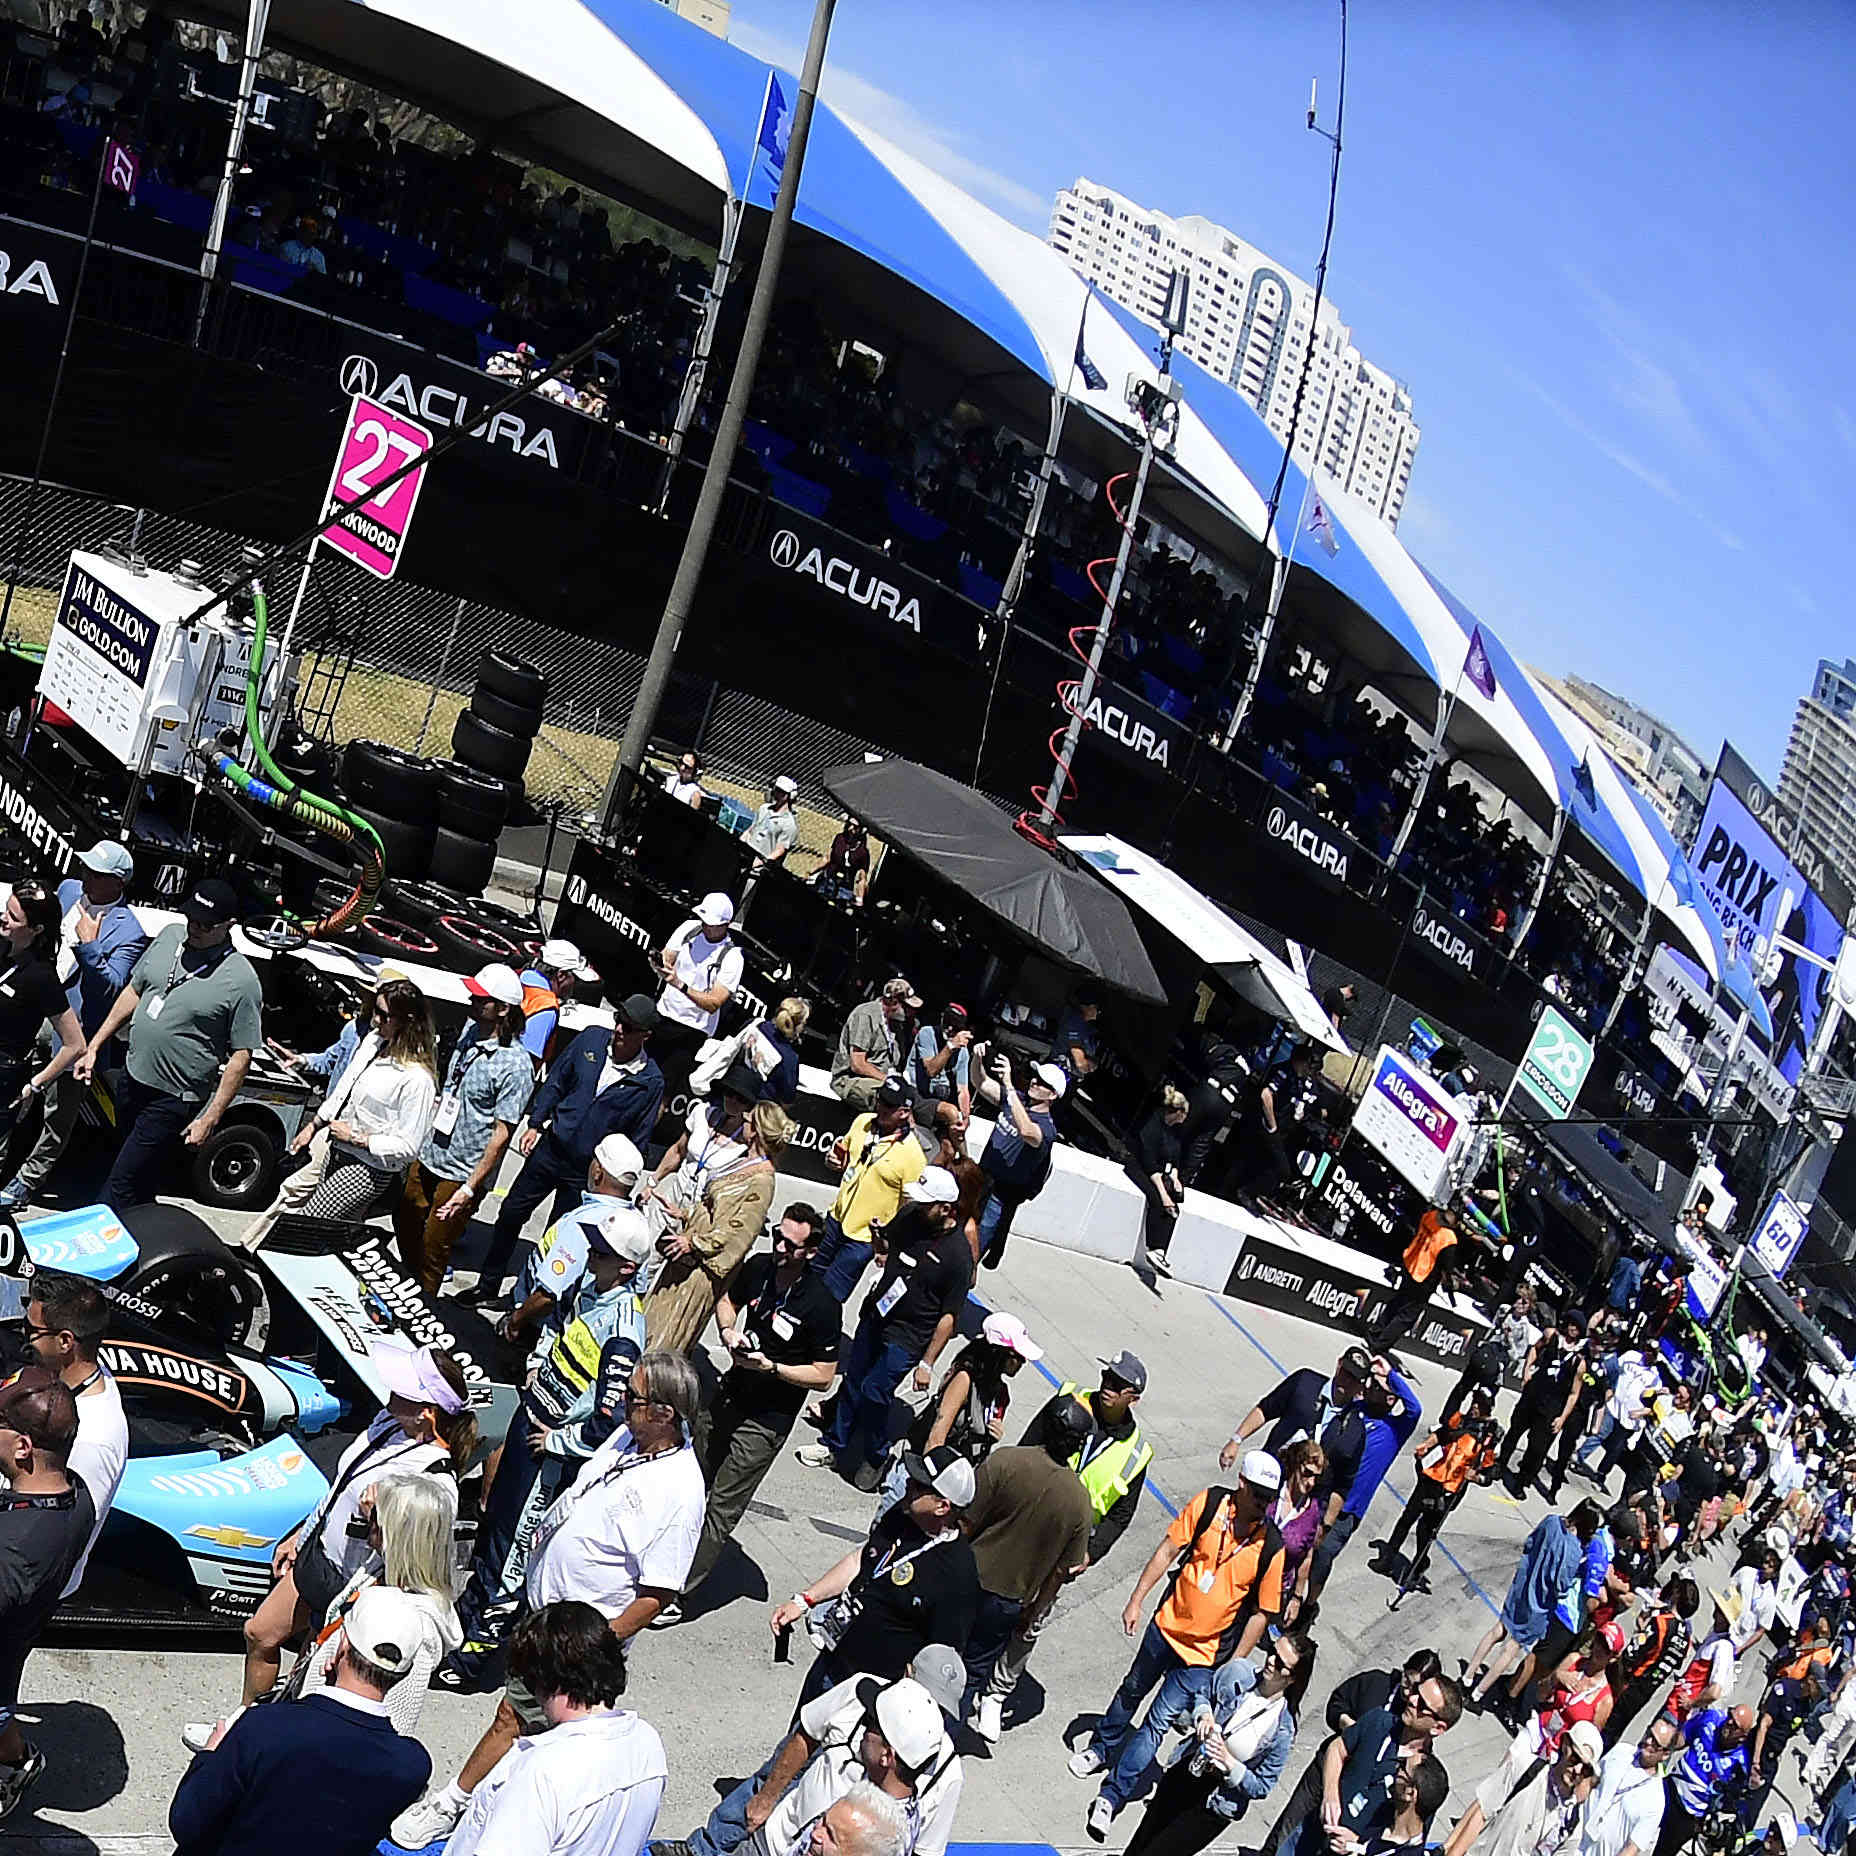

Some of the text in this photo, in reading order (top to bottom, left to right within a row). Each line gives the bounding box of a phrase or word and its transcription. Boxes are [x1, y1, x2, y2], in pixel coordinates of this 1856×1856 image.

[111, 147, 133, 191] 27
[379, 374, 559, 469] ACURA
[341, 421, 426, 508] 27
[329, 503, 397, 553] KKWOOD
[71, 570, 151, 647] JM BULLION
[795, 547, 921, 632] ACURA
[79, 617, 142, 677] GOLD.COM
[1084, 697, 1168, 769] ACURA
[1282, 820, 1348, 882] ACURA
[1699, 826, 1775, 923] PRIX
[1765, 816, 1824, 893] ACURA
[587, 893, 651, 950] ANDRETTI
[1421, 919, 1475, 972] ACURA
[1535, 1023, 1584, 1087] 28
[1382, 1071, 1439, 1133] Allegra
[1524, 1061, 1569, 1111] ERICSSON
[1766, 1219, 1792, 1252] 60
[117, 1293, 163, 1319] ROSSI
[314, 1285, 358, 1318] PEEL
[1254, 1261, 1361, 1318] ANDRETTI Allegra
[96, 1346, 136, 1377] VA
[1420, 1319, 1466, 1357] Allegra
